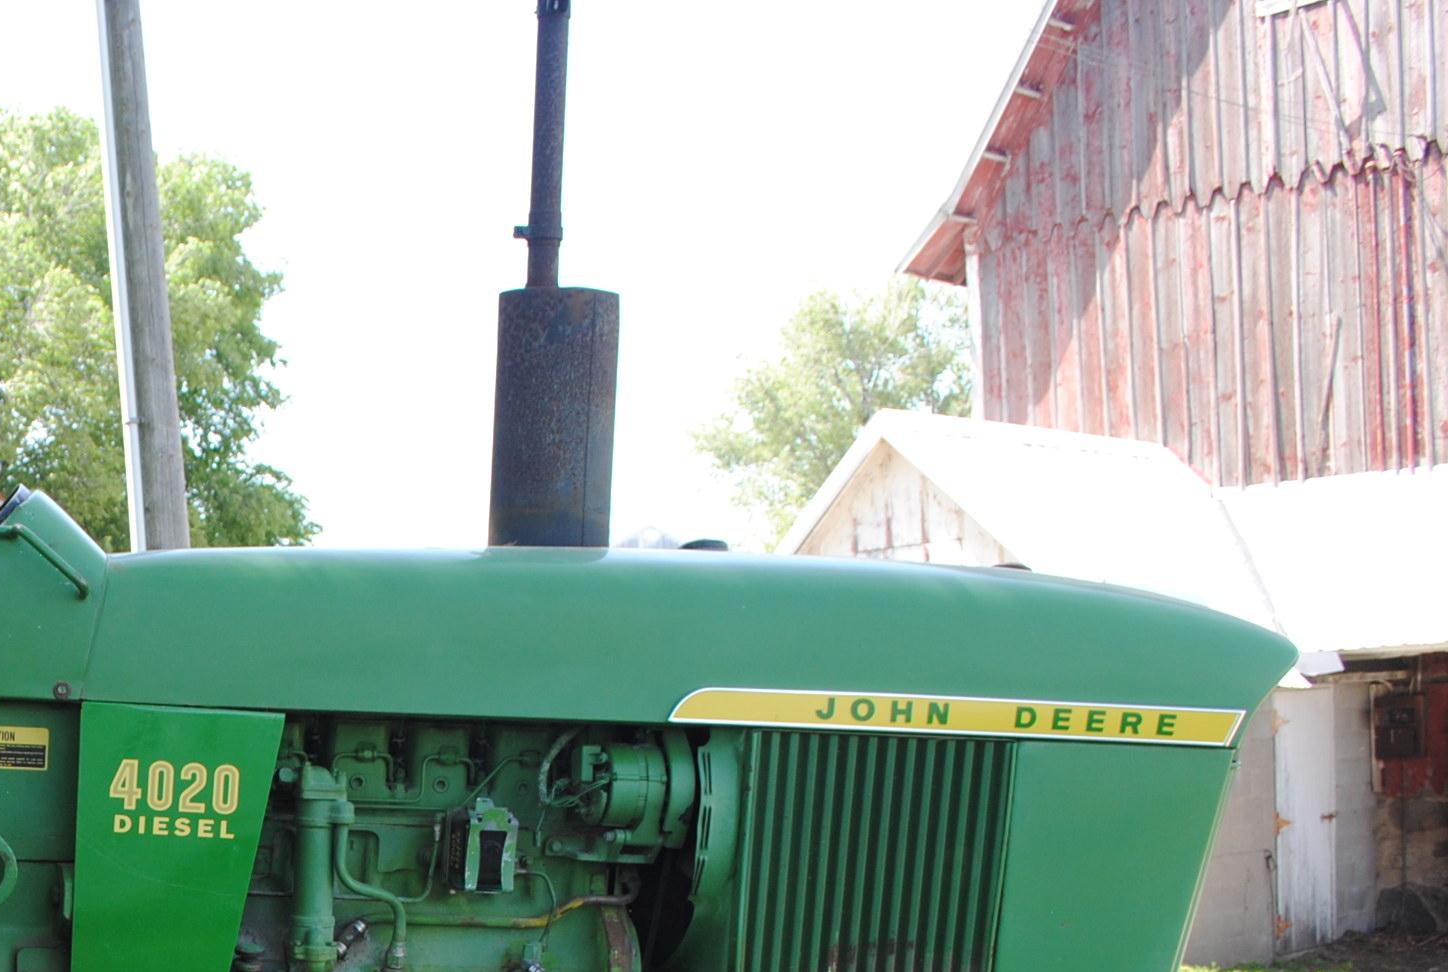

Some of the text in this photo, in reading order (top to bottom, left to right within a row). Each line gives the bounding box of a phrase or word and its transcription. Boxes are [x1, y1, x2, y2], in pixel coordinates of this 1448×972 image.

[815, 697, 1177, 737] JOHN DEERE
[109, 758, 241, 816] 4020
[113, 814, 236, 839] DIESEL
